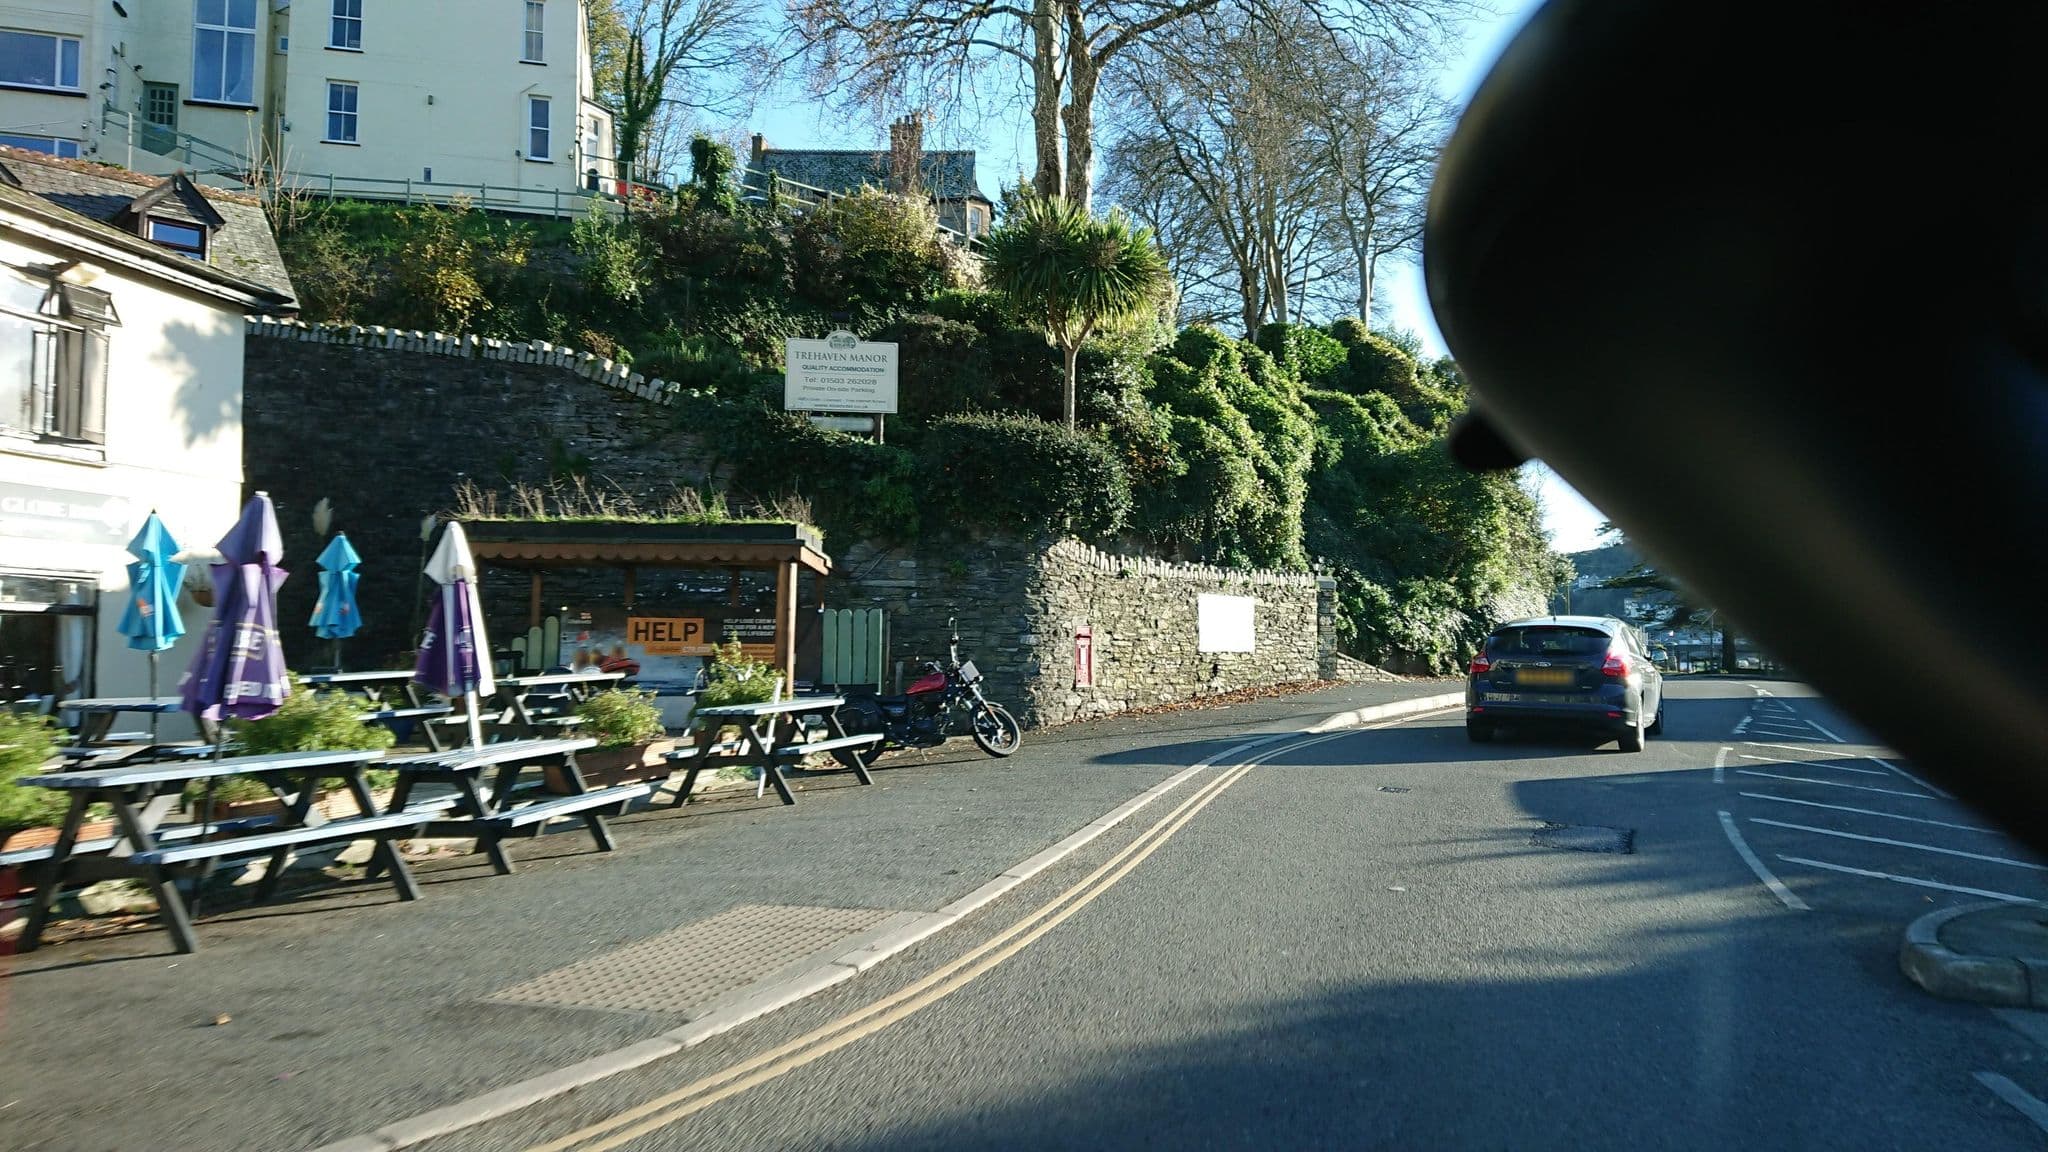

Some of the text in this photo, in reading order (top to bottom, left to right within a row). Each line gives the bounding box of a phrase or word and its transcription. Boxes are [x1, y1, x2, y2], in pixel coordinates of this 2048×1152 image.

[795, 351, 888, 363] TREHAVEN MANOR
[829, 365, 885, 373] ACCOMMODATION
[634, 621, 699, 642] HELP
